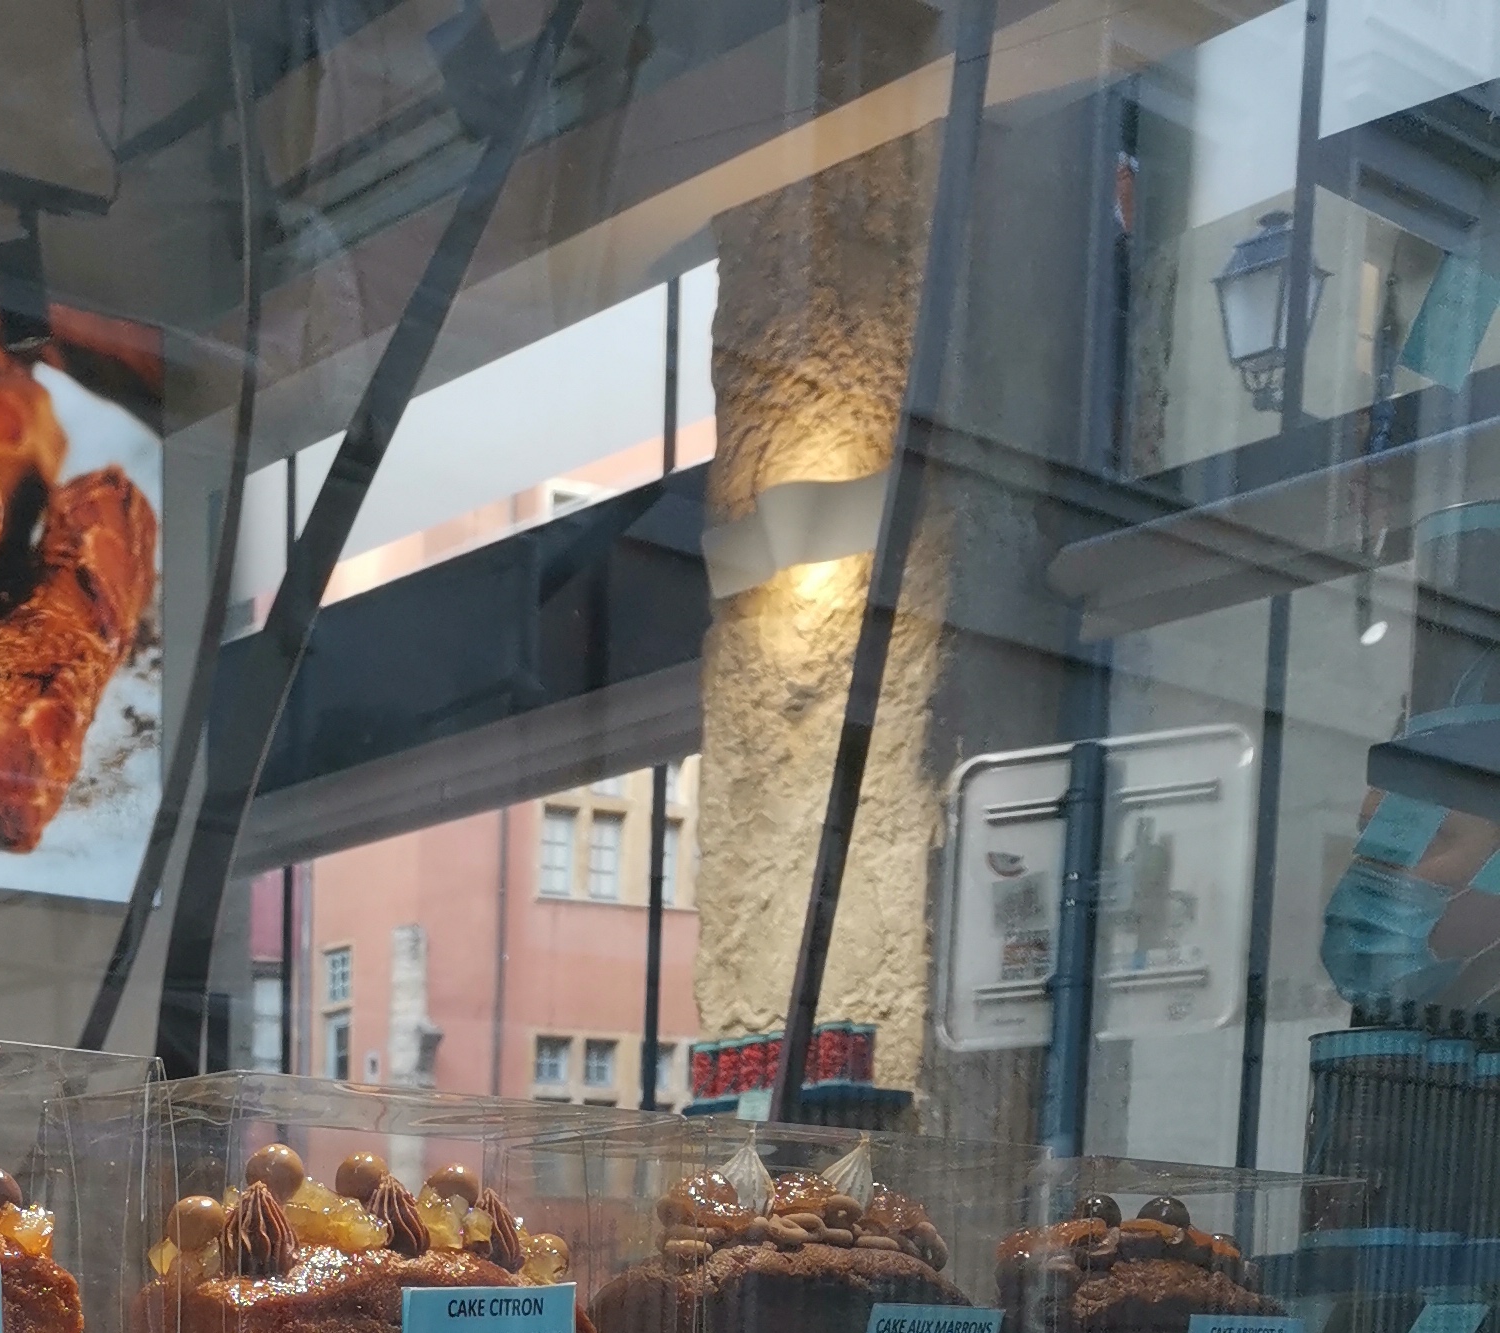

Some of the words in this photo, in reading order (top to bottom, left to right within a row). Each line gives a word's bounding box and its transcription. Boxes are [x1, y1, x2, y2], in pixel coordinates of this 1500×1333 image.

[448, 1298, 484, 1317] CAKE
[490, 1297, 543, 1316] CITRON
[875, 1318, 906, 1333] CAKE
